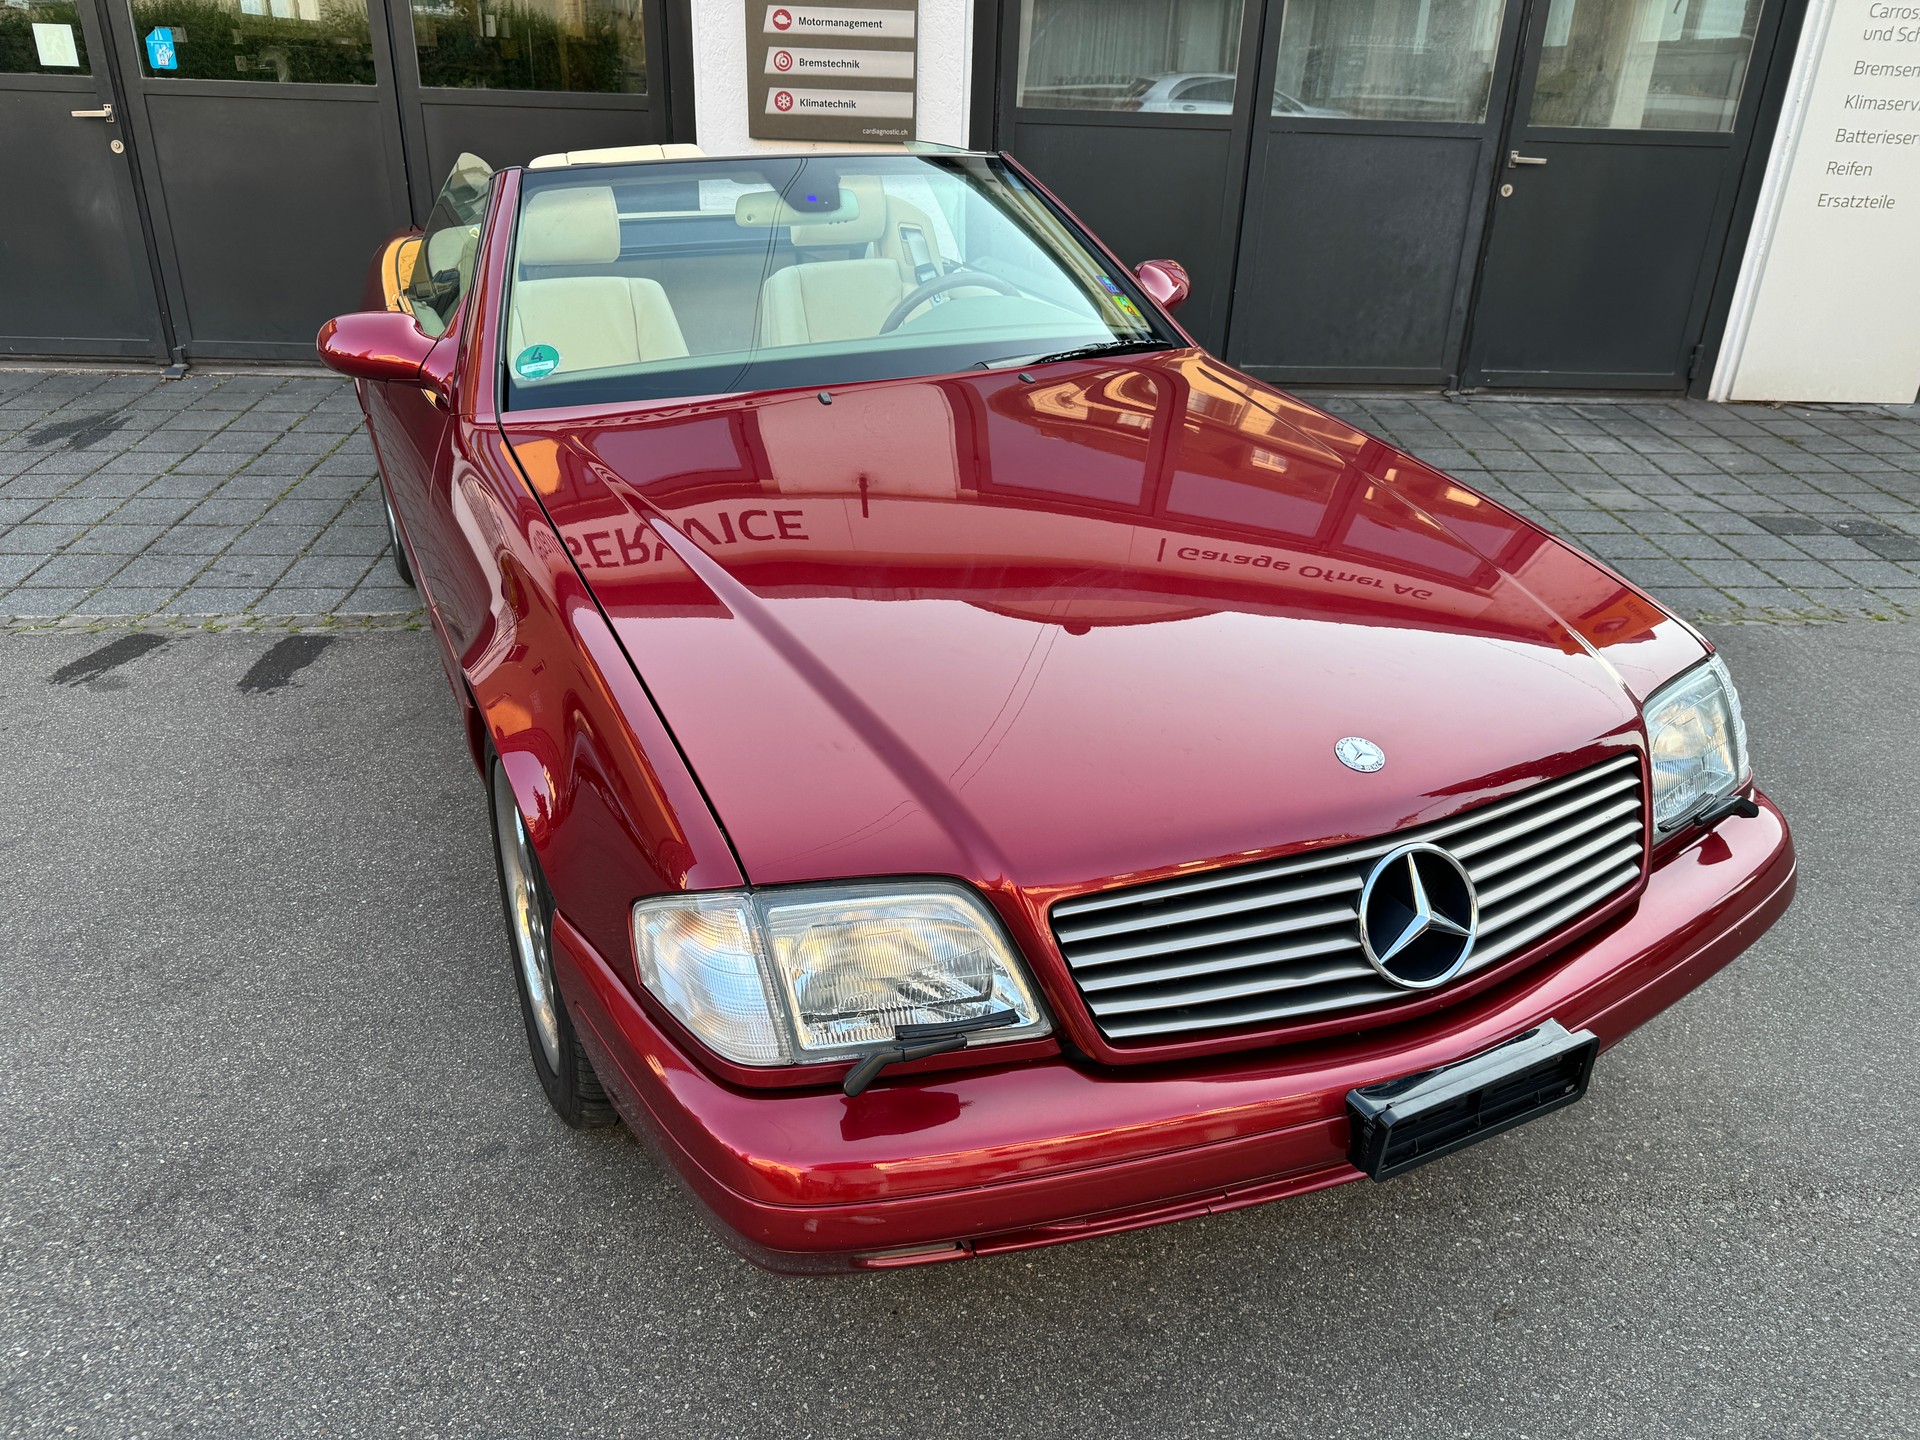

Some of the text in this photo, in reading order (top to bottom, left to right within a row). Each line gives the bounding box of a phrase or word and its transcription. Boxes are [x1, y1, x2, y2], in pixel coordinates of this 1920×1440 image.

[1870, 2, 1920, 20] Carros
[798, 16, 883, 30] Motormanagement
[1863, 25, 1895, 42] und
[799, 58, 860, 69] Bremstechnik
[800, 98, 857, 109] Klimatechnik
[1844, 94, 1920, 111] Klimaserv
[862, 127, 908, 136] cardiagnostic.ch
[1835, 128, 1920, 145] Batterieser
[1826, 161, 1873, 176] Reifen
[1817, 193, 1896, 209] Ersatzteile
[531, 346, 544, 361] 4
